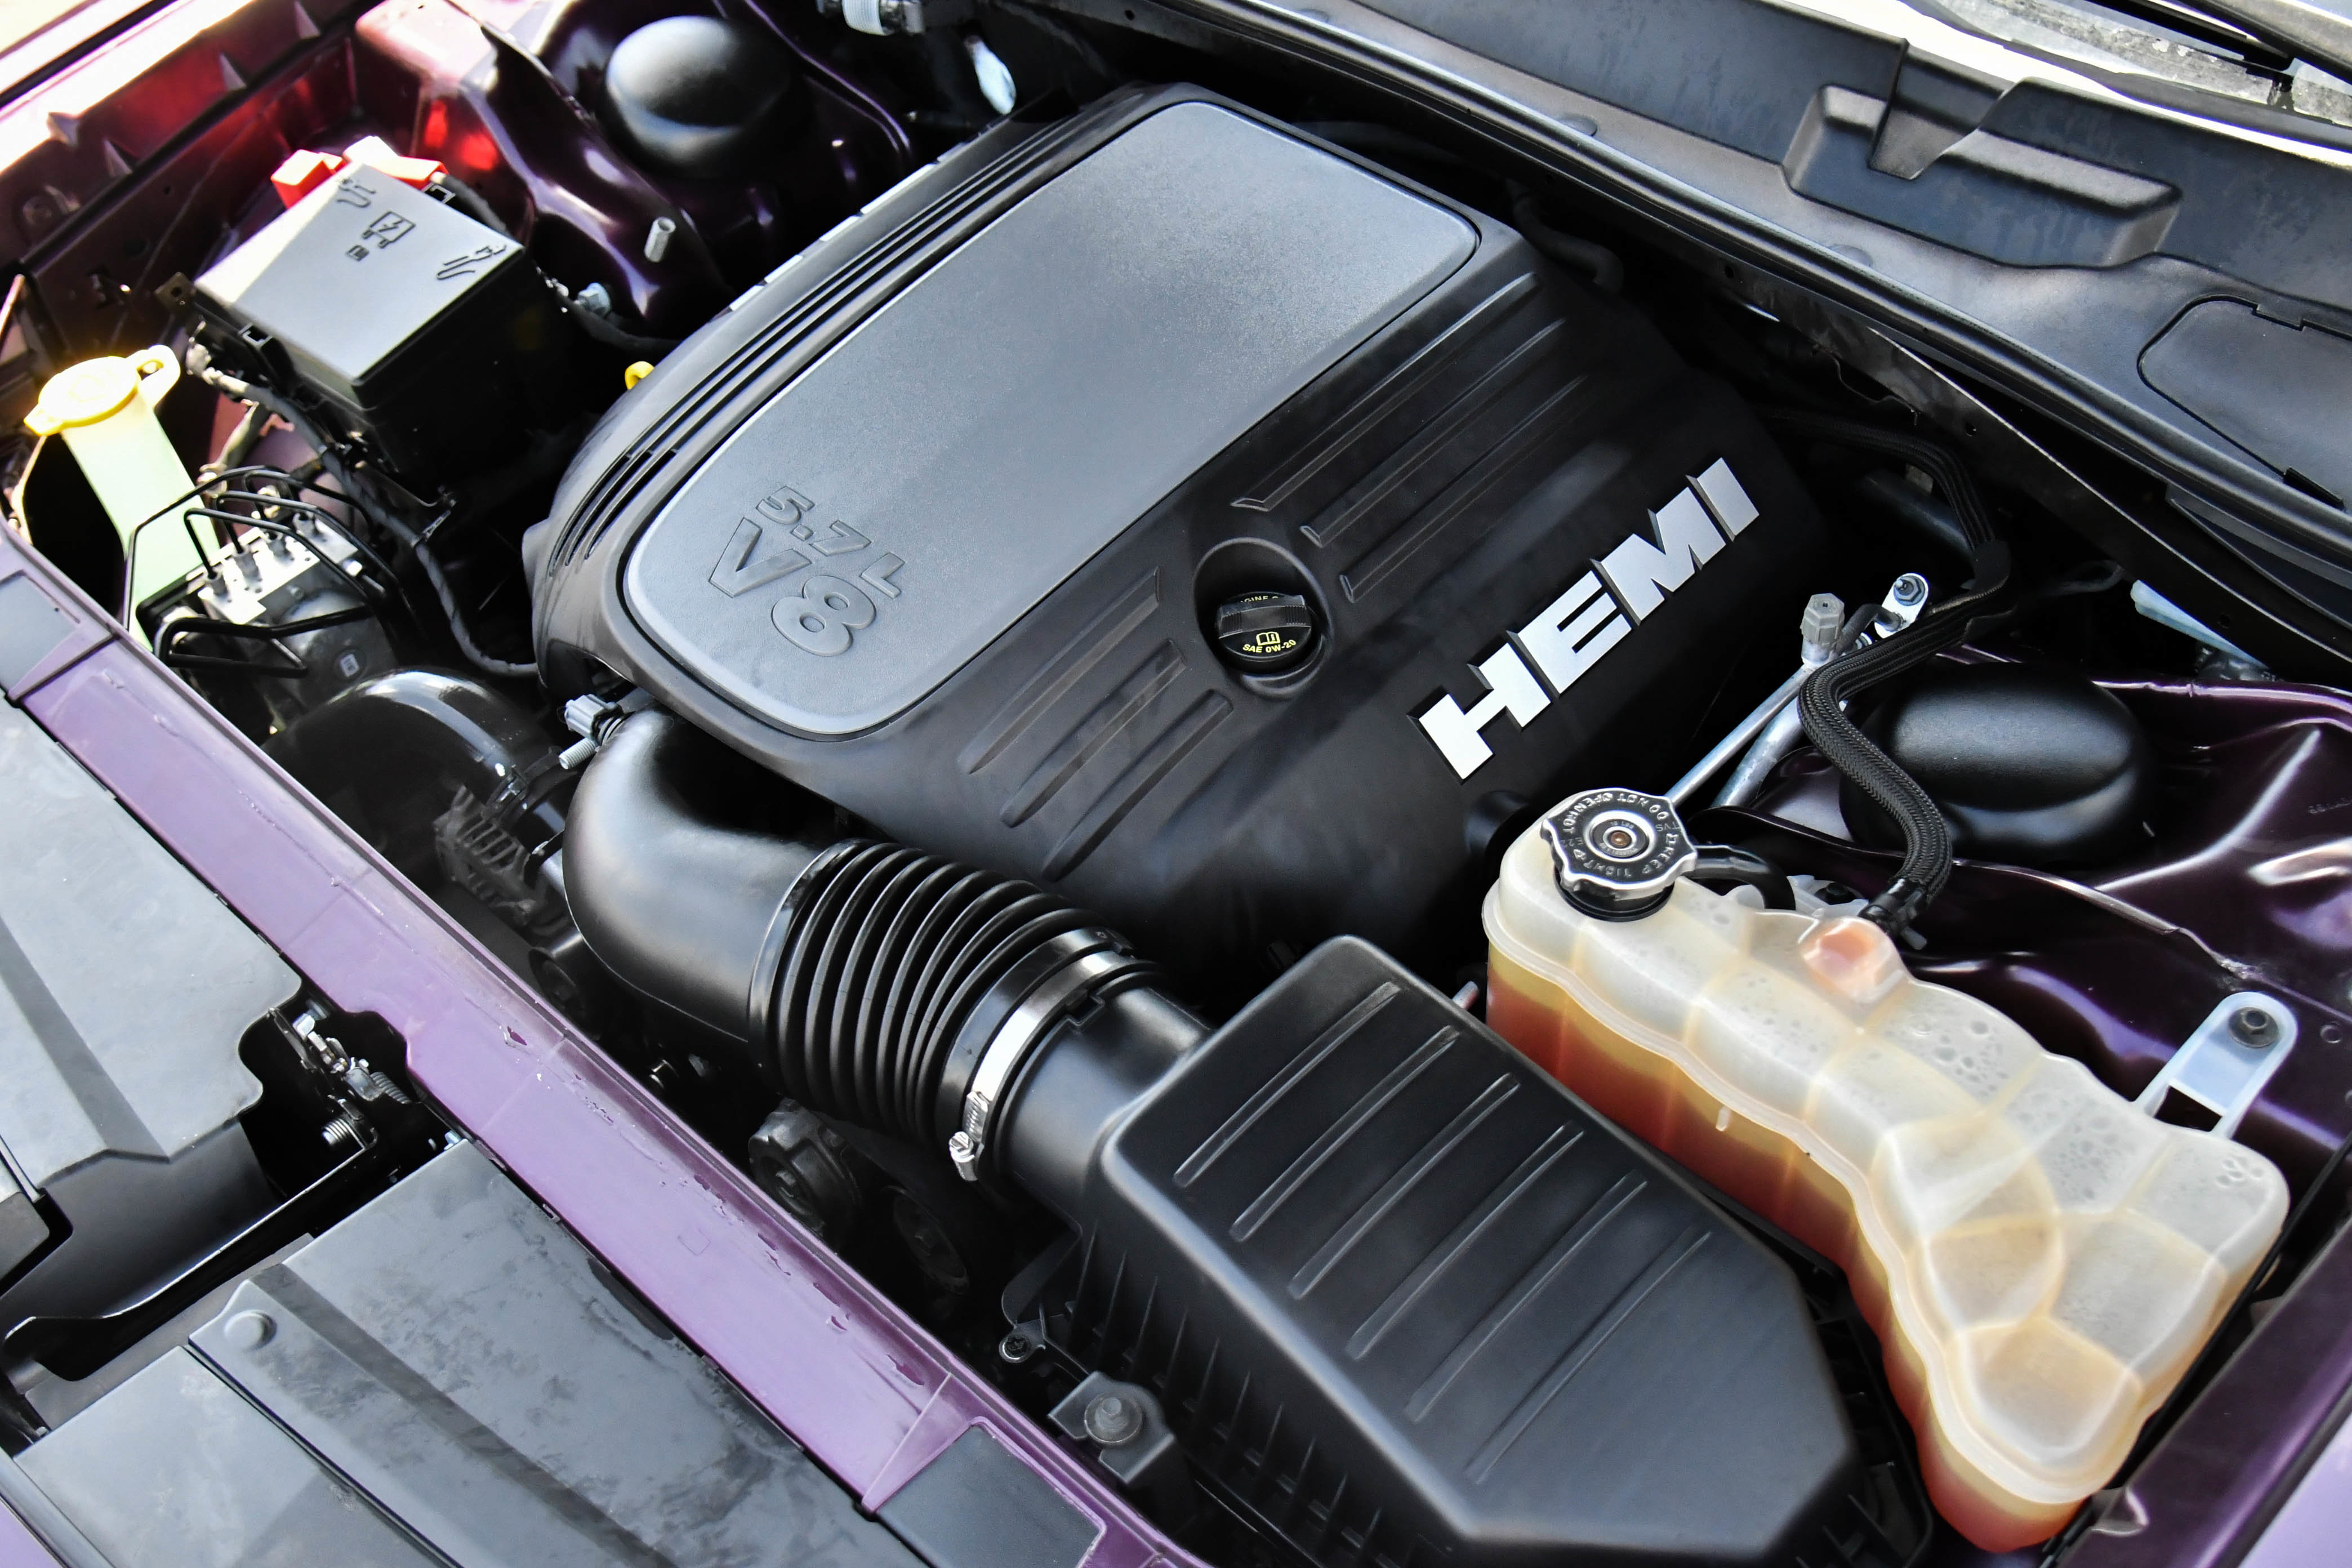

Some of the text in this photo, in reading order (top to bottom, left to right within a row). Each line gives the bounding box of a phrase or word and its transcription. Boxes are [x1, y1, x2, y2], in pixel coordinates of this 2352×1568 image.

[756, 485, 906, 598] 5.7L
[708, 516, 876, 657] V8
[1407, 457, 1759, 785] HEMI
[1242, 639, 1297, 653] SAE 0W-20
[1562, 792, 1669, 834] DO NOT OPEN HOT
[1583, 859, 1632, 877] TIGHT
[1641, 846, 1674, 874] KEEP
